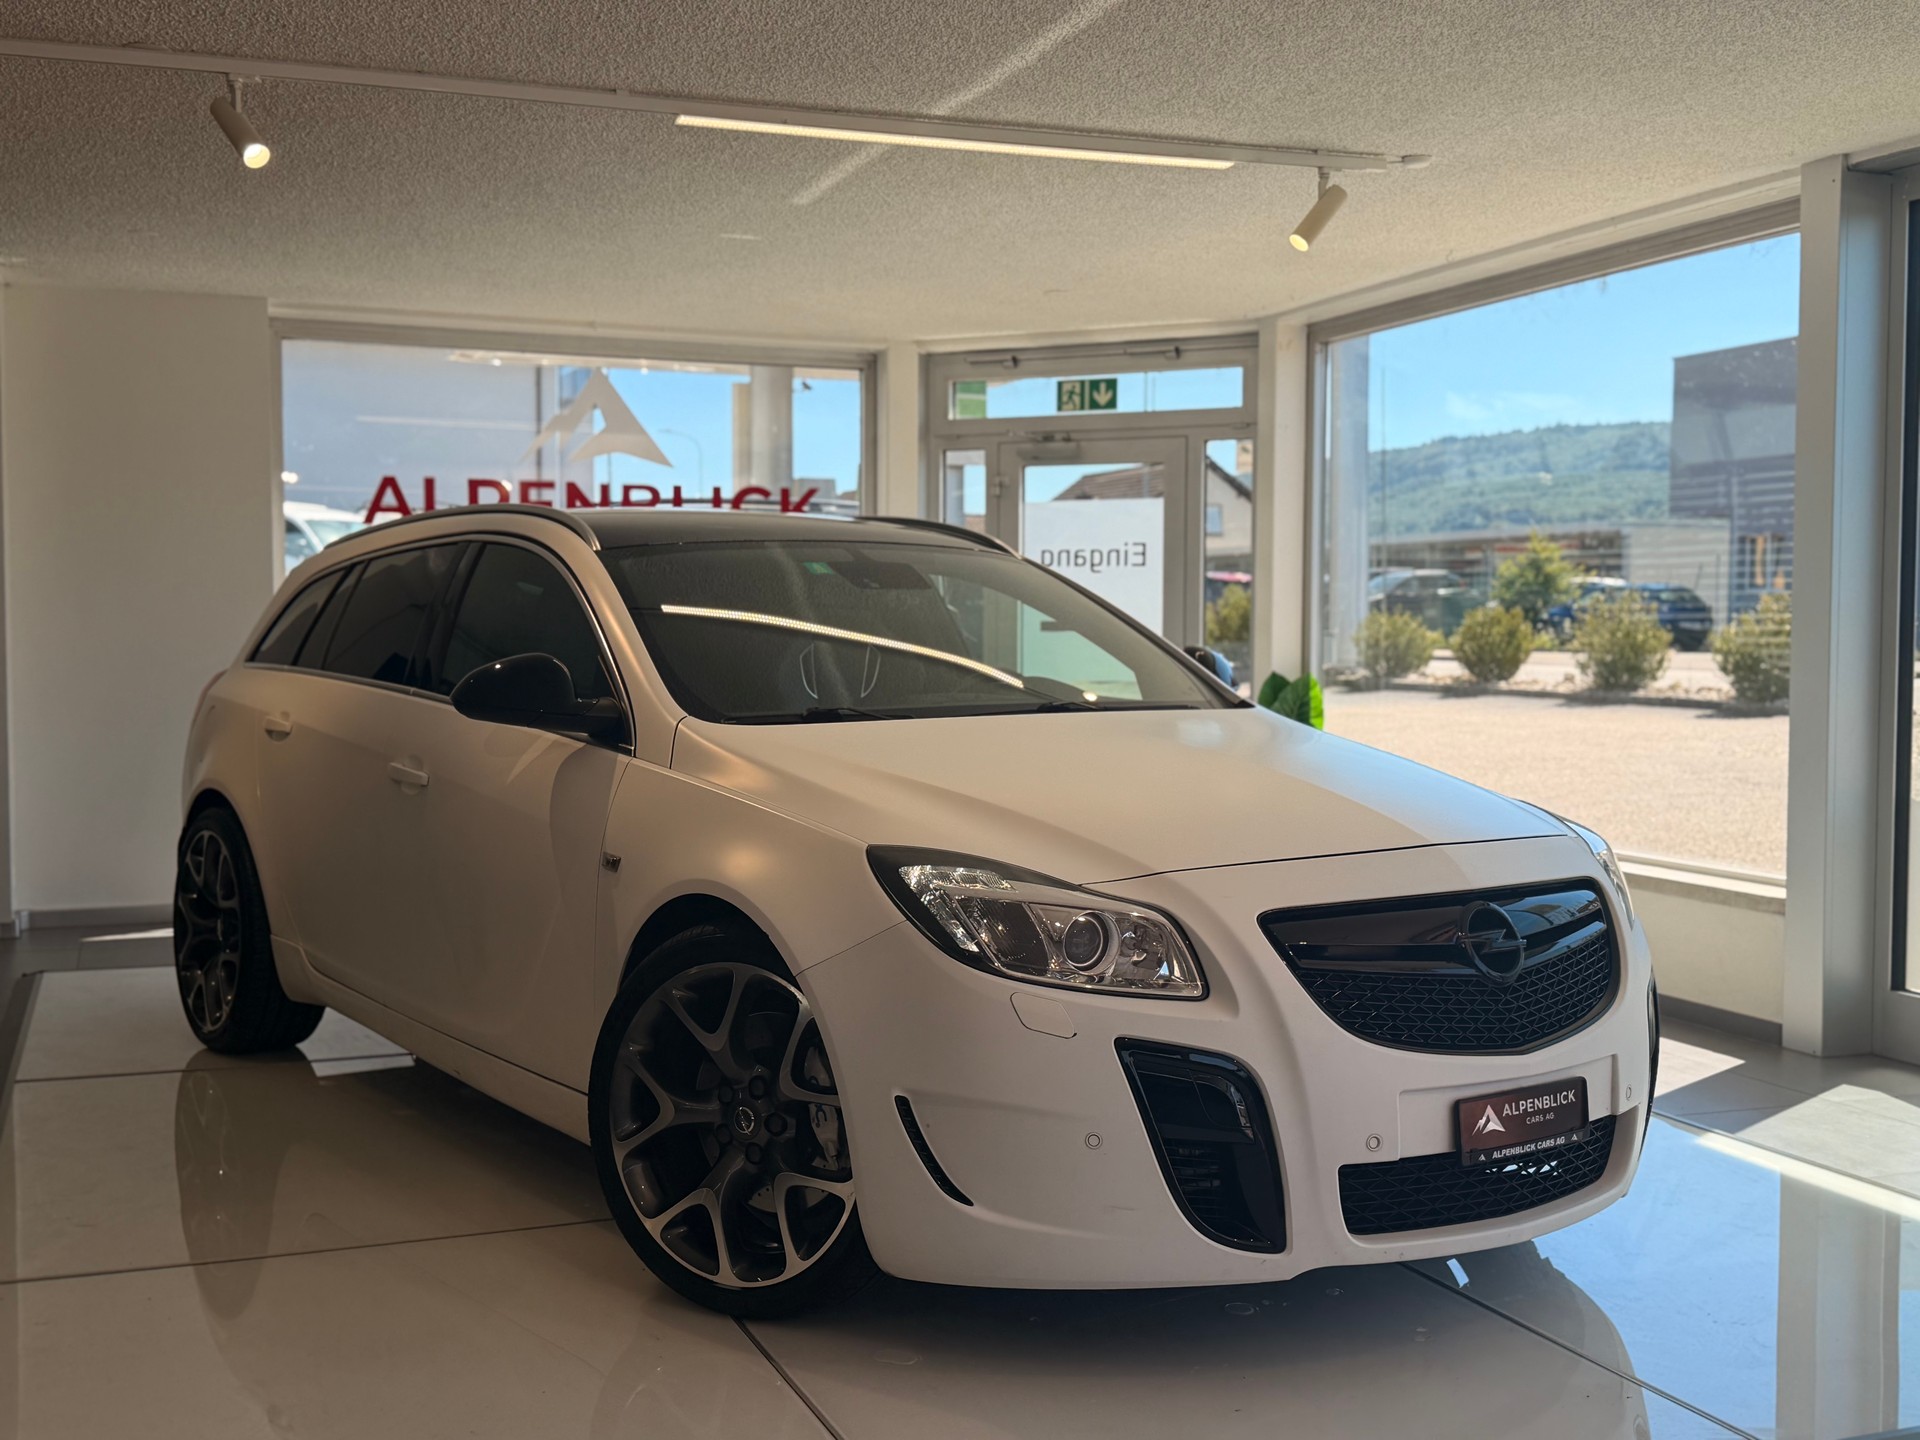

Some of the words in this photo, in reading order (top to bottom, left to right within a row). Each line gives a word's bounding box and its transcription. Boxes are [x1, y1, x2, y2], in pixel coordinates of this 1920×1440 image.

[1502, 1089, 1576, 1117] ALPENBLICK
[1526, 1114, 1544, 1124] CARS
[1545, 1112, 1555, 1120] AG
[1492, 1142, 1536, 1159] ALPENBLICK
[1537, 1138, 1555, 1149] CARS
[1555, 1136, 1566, 1146] AG
